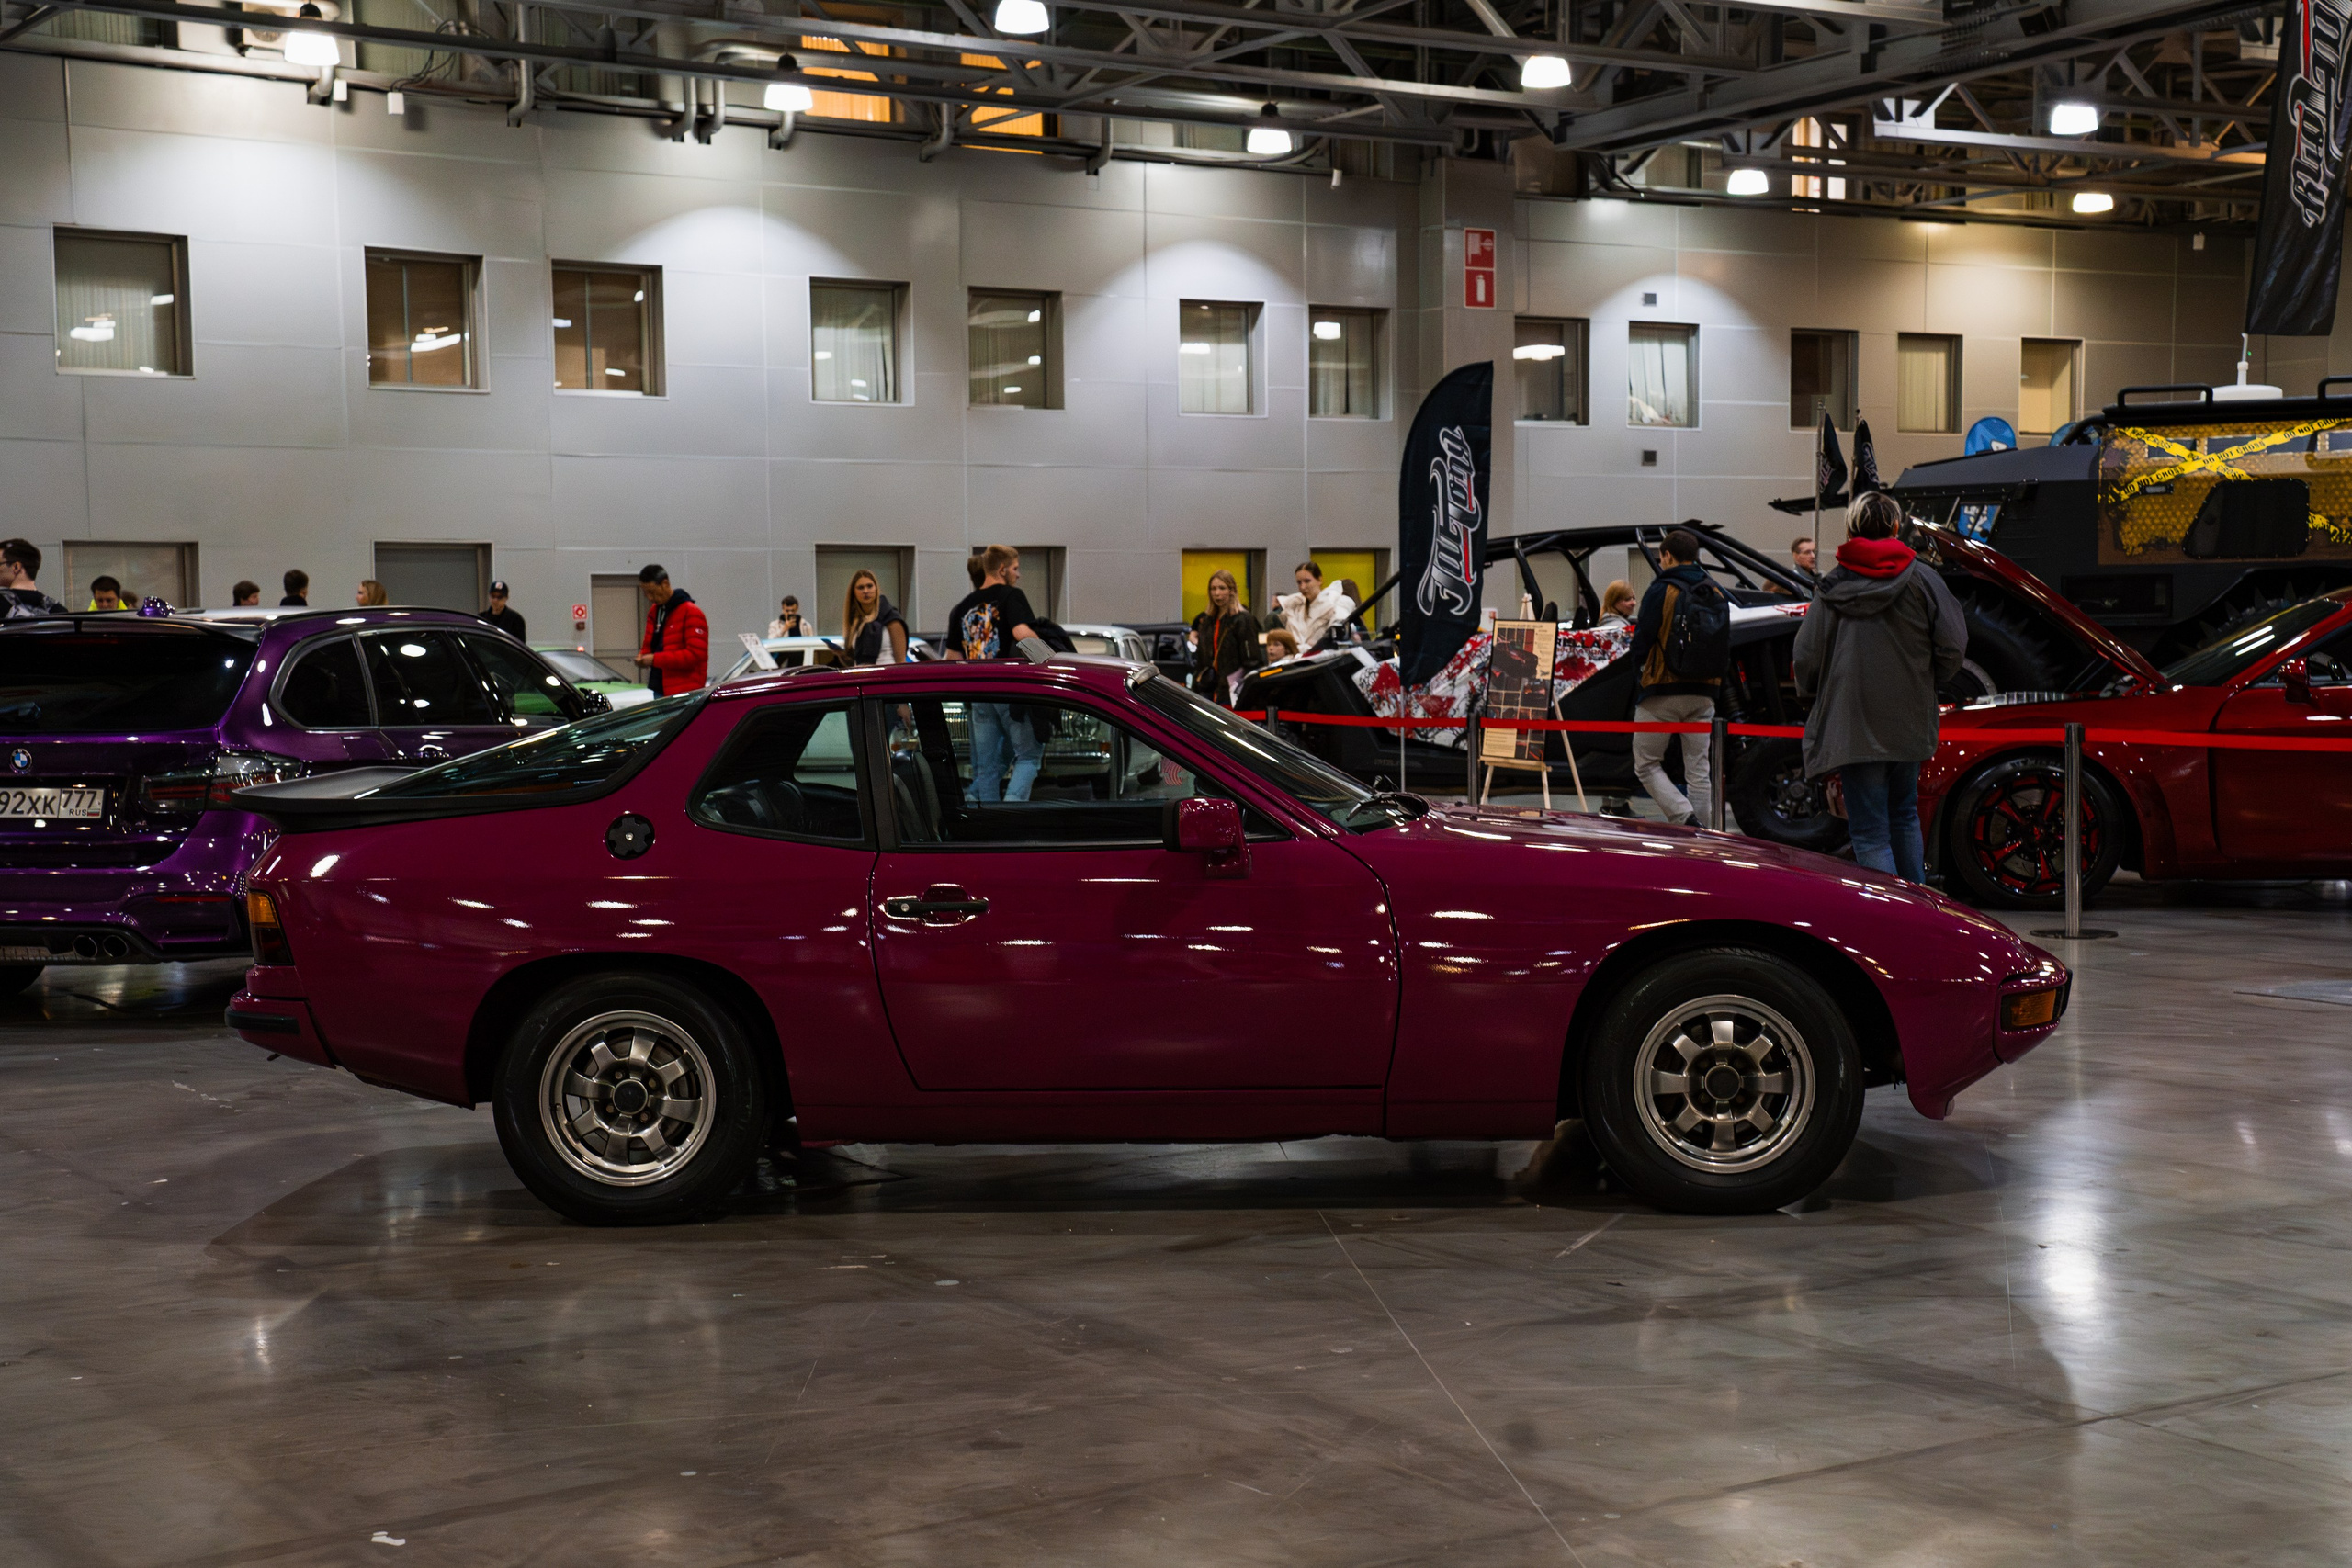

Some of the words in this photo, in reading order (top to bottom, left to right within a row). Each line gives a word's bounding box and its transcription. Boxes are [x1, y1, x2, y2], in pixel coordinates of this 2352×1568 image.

[2298, 424, 2315, 434] NOT
[2217, 450, 2233, 460] NOT
[2137, 476, 2154, 487] NOT
[2156, 466, 2185, 480] CROSS
[62, 790, 97, 808] 777
[69, 808, 87, 817] RUS
